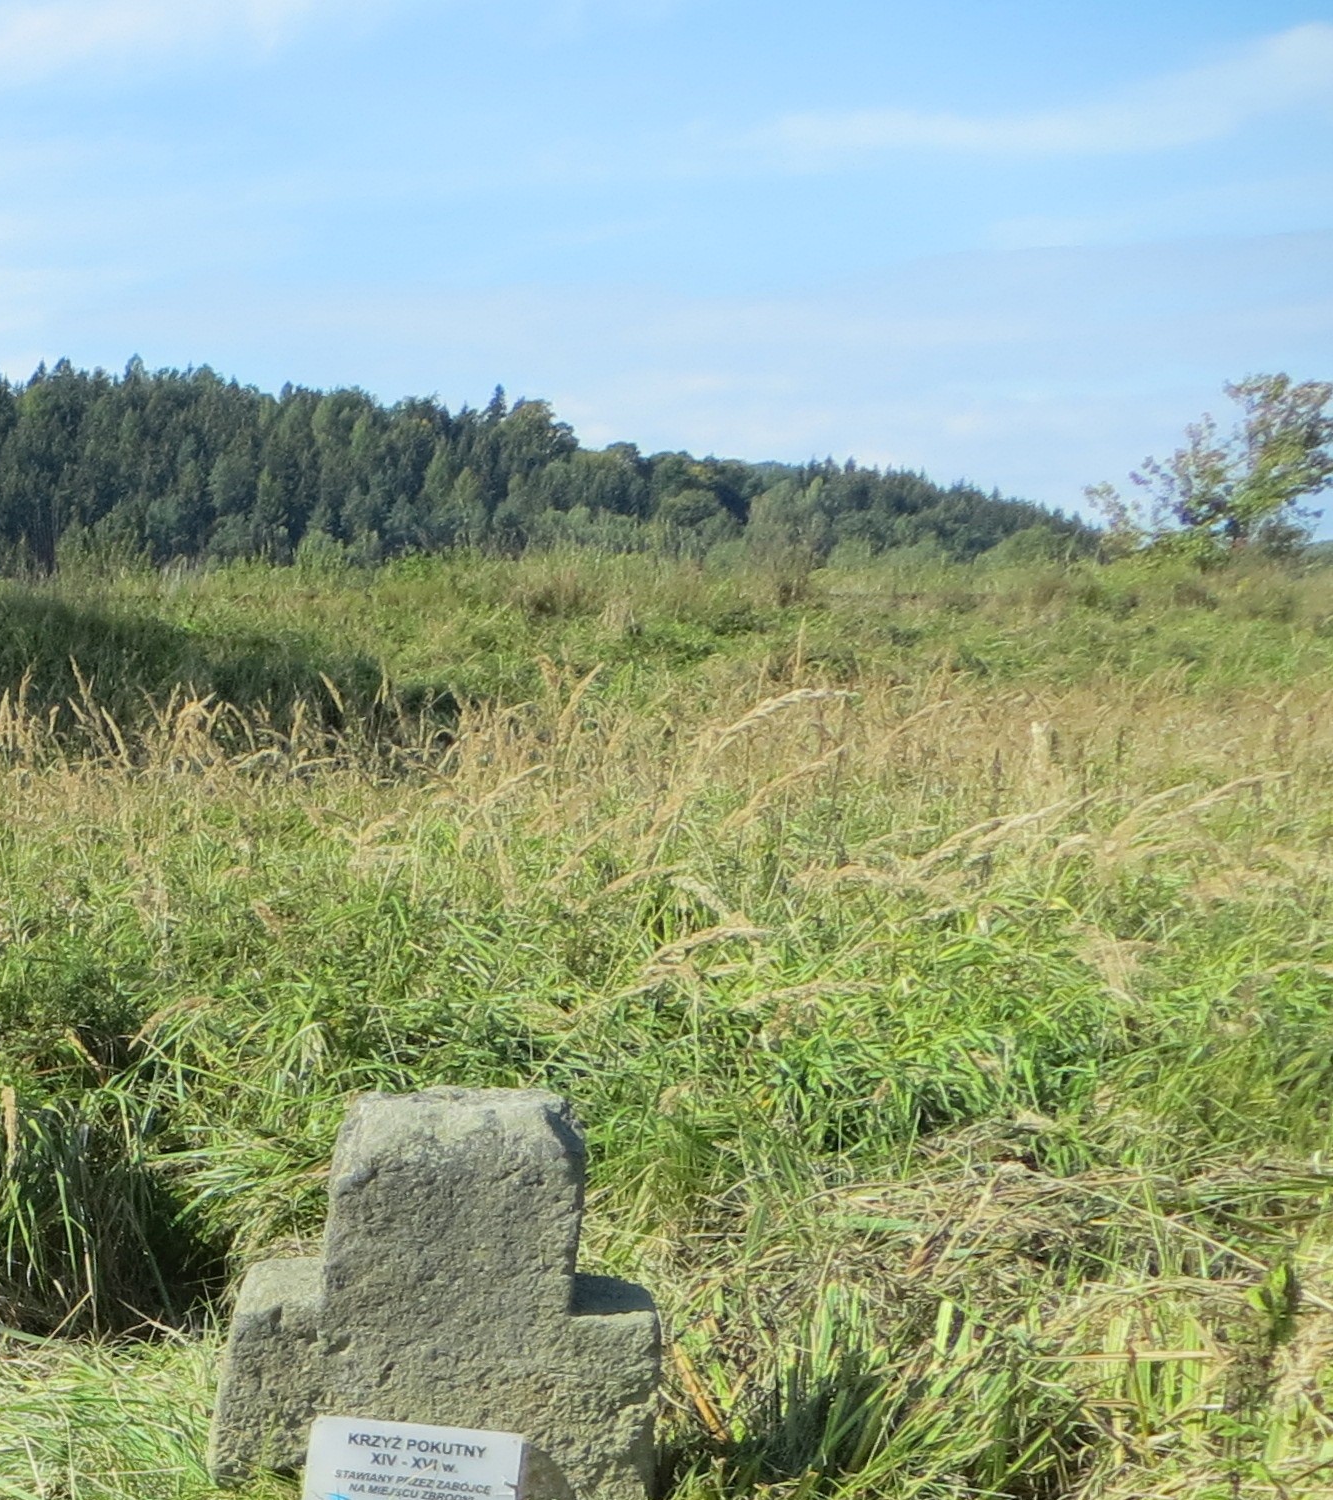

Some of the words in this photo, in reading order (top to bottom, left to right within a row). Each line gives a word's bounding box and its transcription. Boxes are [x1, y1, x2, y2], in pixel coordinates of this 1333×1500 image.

[348, 1431, 402, 1450] KRZYŻ
[406, 1438, 486, 1459] POKUTNY
[370, 1452, 397, 1467] XIV
[411, 1456, 438, 1471] XVI
[334, 1469, 394, 1484] STAWIANY
[349, 1483, 365, 1493] NA
